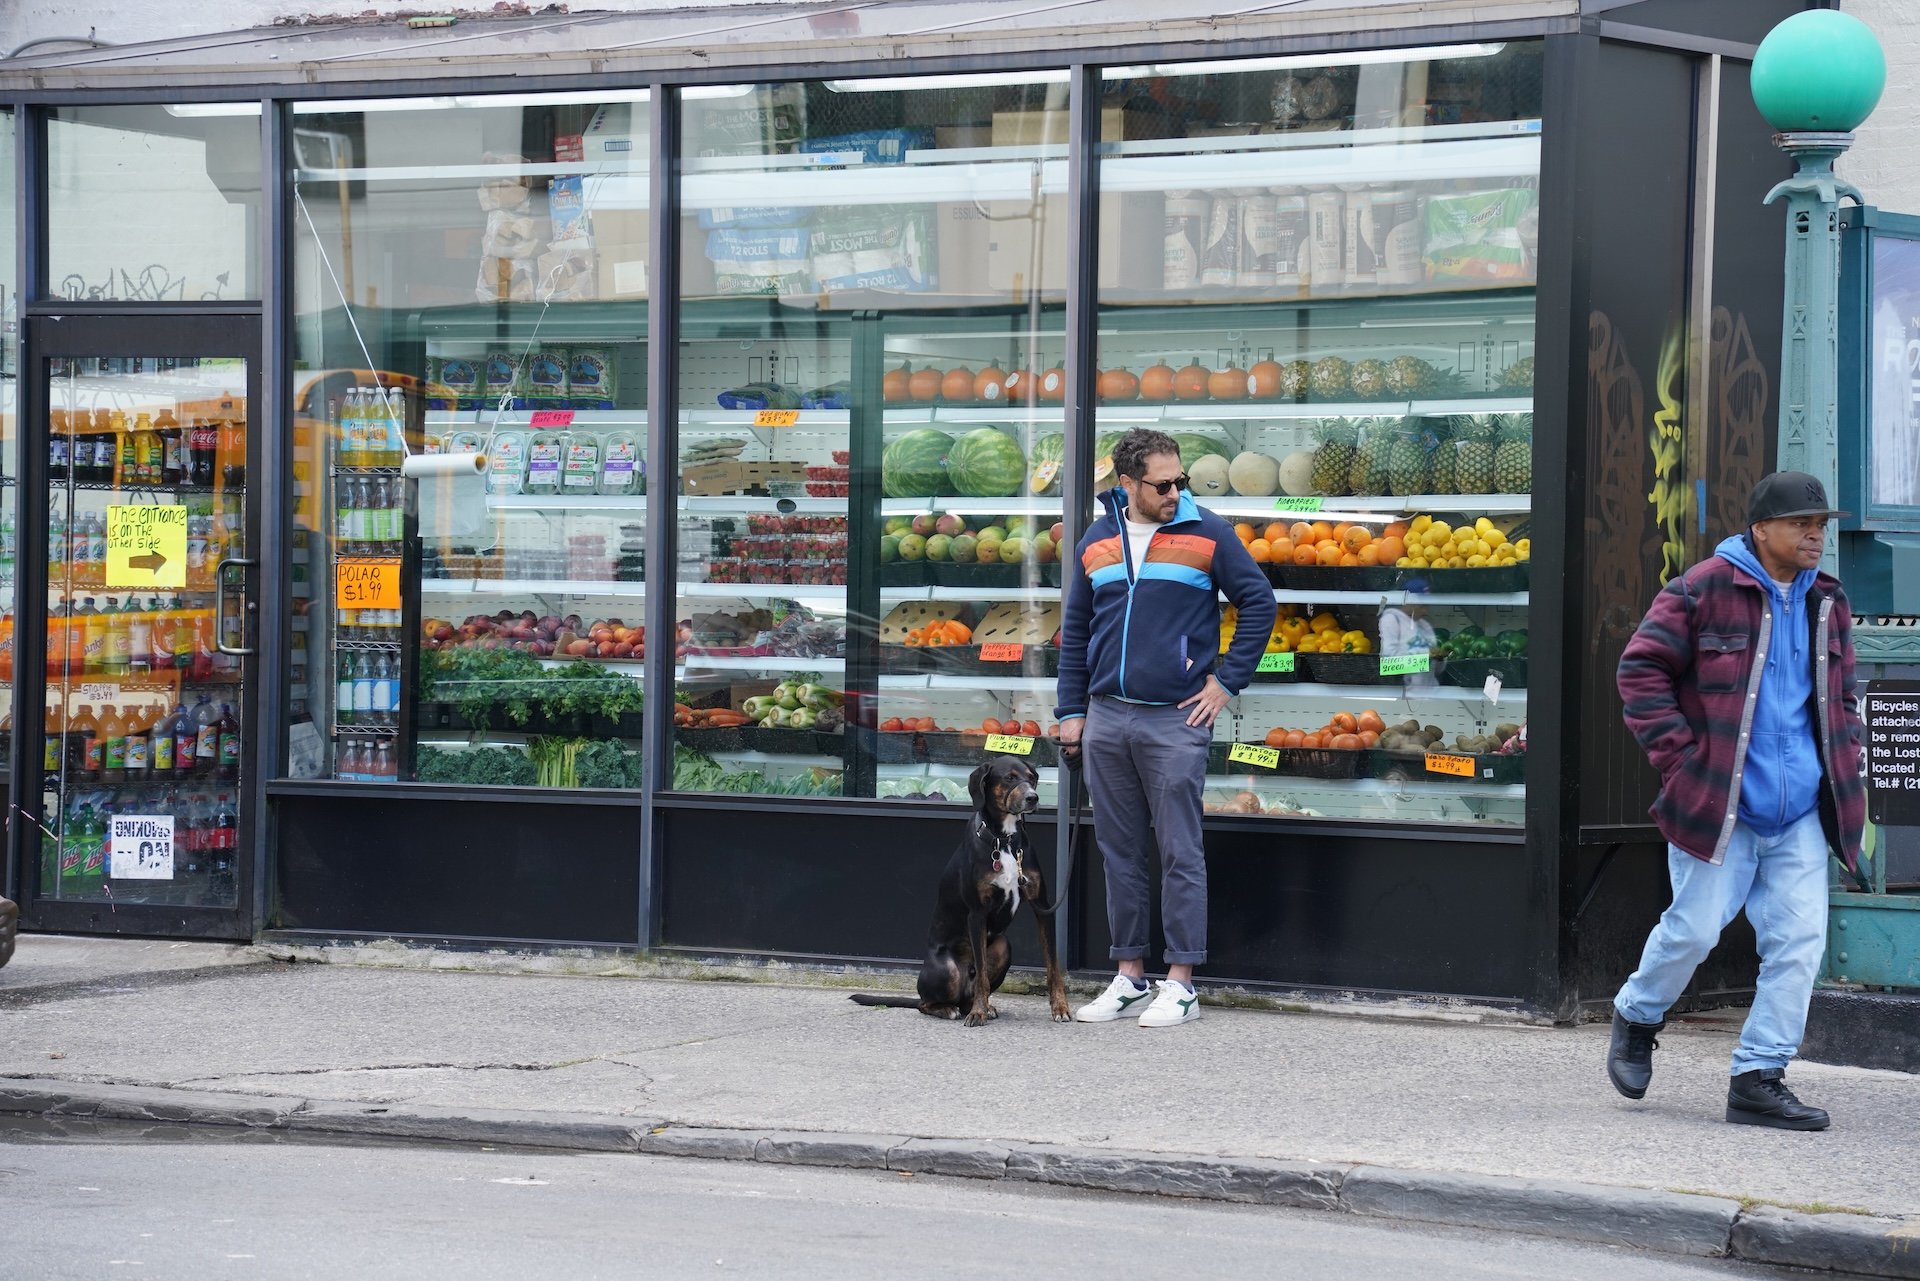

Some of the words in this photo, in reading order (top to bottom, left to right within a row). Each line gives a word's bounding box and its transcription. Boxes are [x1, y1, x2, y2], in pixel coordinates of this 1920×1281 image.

[110, 505, 137, 523] The
[120, 524, 132, 538] on
[137, 536, 161, 550] side
[339, 565, 381, 582] POLAR
[344, 580, 382, 602] $1.99
[1382, 663, 1405, 673] green
[1871, 700, 1919, 714] Bicycles
[1871, 731, 1887, 742] be
[1872, 746, 1891, 758] the
[1872, 762, 1915, 773] located
[1873, 777, 1900, 788] Tel.#
